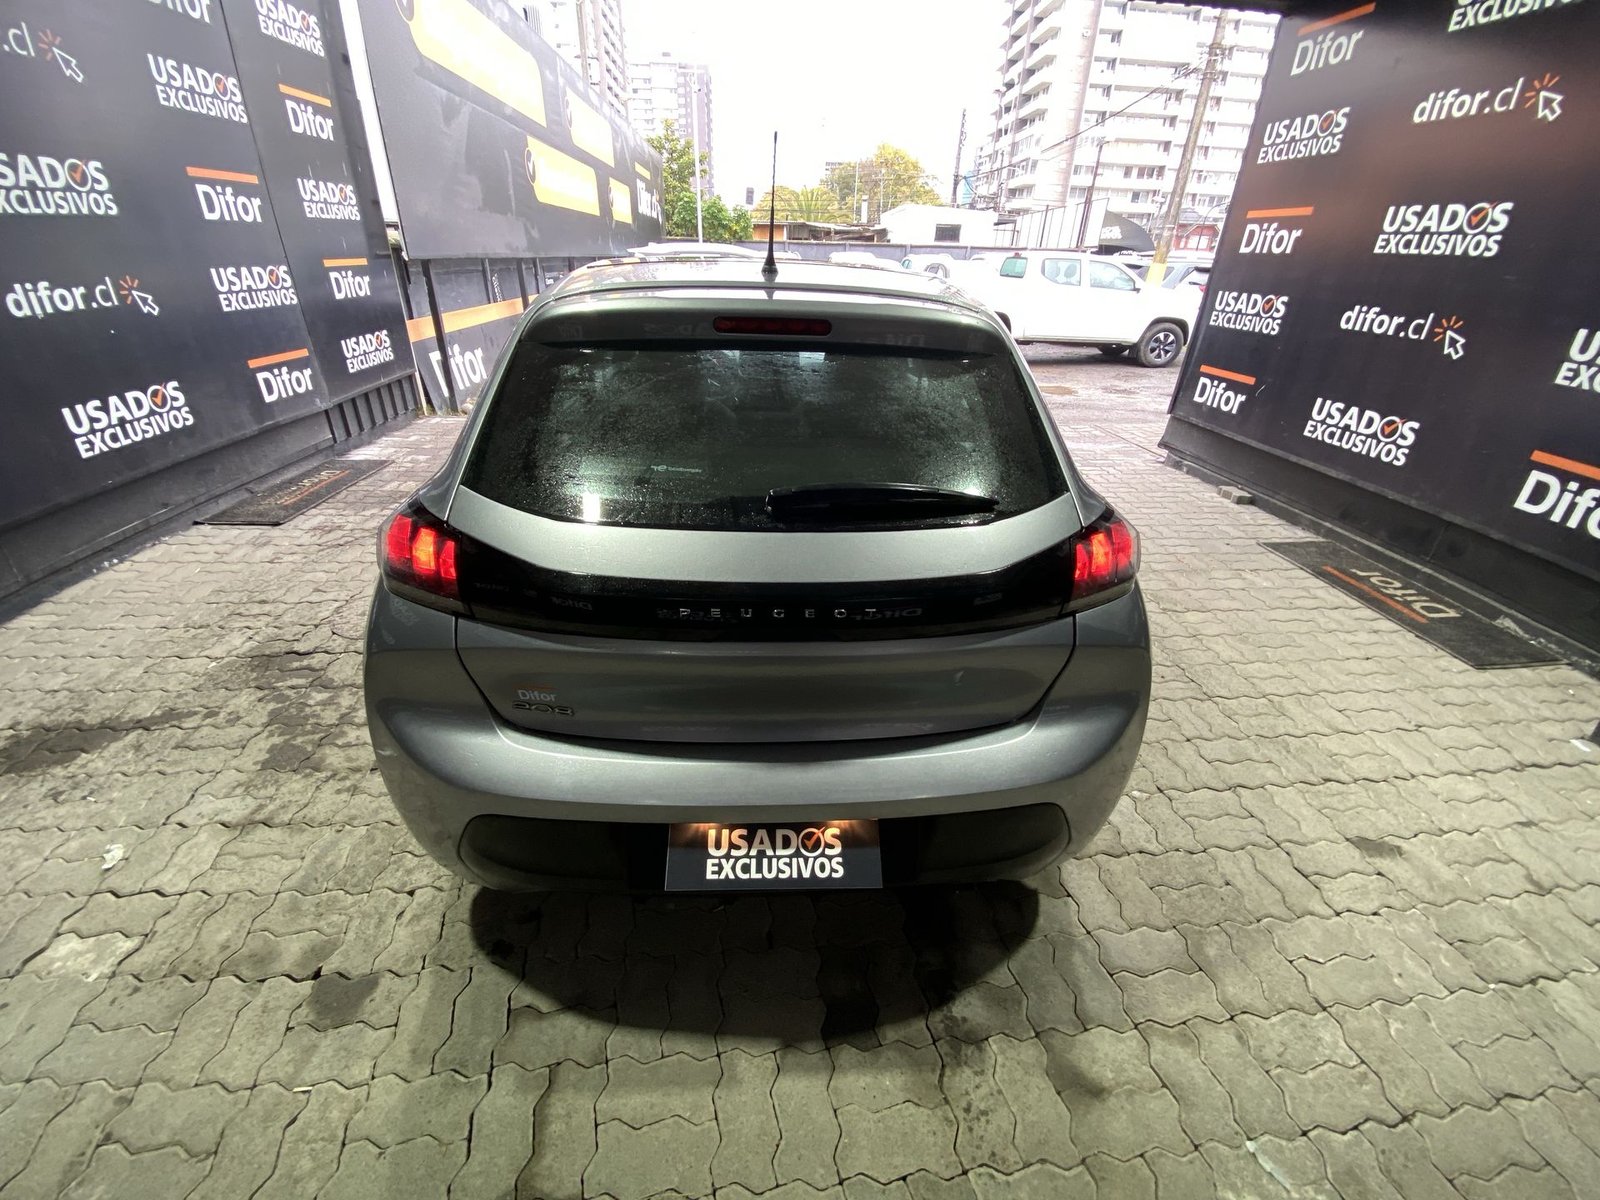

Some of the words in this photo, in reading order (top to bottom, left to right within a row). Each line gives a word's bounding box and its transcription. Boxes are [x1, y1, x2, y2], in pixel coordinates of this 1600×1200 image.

[255, 0, 321, 38] USADOS
[258, 14, 325, 57] EXCLUSIVOS
[1290, 30, 1364, 76] Difor
[147, 54, 241, 102] USADOS
[155, 85, 248, 124] EXCLUSIVOS
[1412, 78, 1525, 124] difor.cl
[285, 100, 334, 141] Difor
[1263, 107, 1351, 147] USADOS
[1257, 134, 1343, 164] EXCLUSIVOS
[195, 183, 263, 223] Difor
[297, 177, 356, 204] USADOS
[304, 200, 360, 221] EXCLUSIVOS
[1382, 202, 1514, 234] USADOS
[1239, 223, 1302, 254] Difor
[1373, 232, 1503, 257] EXCLUSIVOS
[210, 265, 292, 293] USADOS
[328, 270, 371, 300] Difor
[6, 276, 119, 318] difor.cl
[218, 287, 298, 312] EXCLUSIVOS
[1214, 291, 1288, 318] USADOS
[1209, 312, 1282, 336] EXCLUSIVOS
[1340, 305, 1434, 340] difor.cl
[341, 330, 390, 358] USADOS
[346, 347, 394, 374] EXCLUSIVOS
[255, 366, 313, 403] Difor
[1193, 377, 1246, 414] Difor
[61, 380, 186, 435] USADOS
[1310, 398, 1421, 446] USADOS
[75, 405, 195, 459] EXCLUSIVOS
[1303, 420, 1409, 466] EXCLUSIVOS
[679, 607, 877, 619] PEUGEOT
[707, 827, 842, 857] USADOS
[706, 856, 844, 881] EXCLUSIVOS
